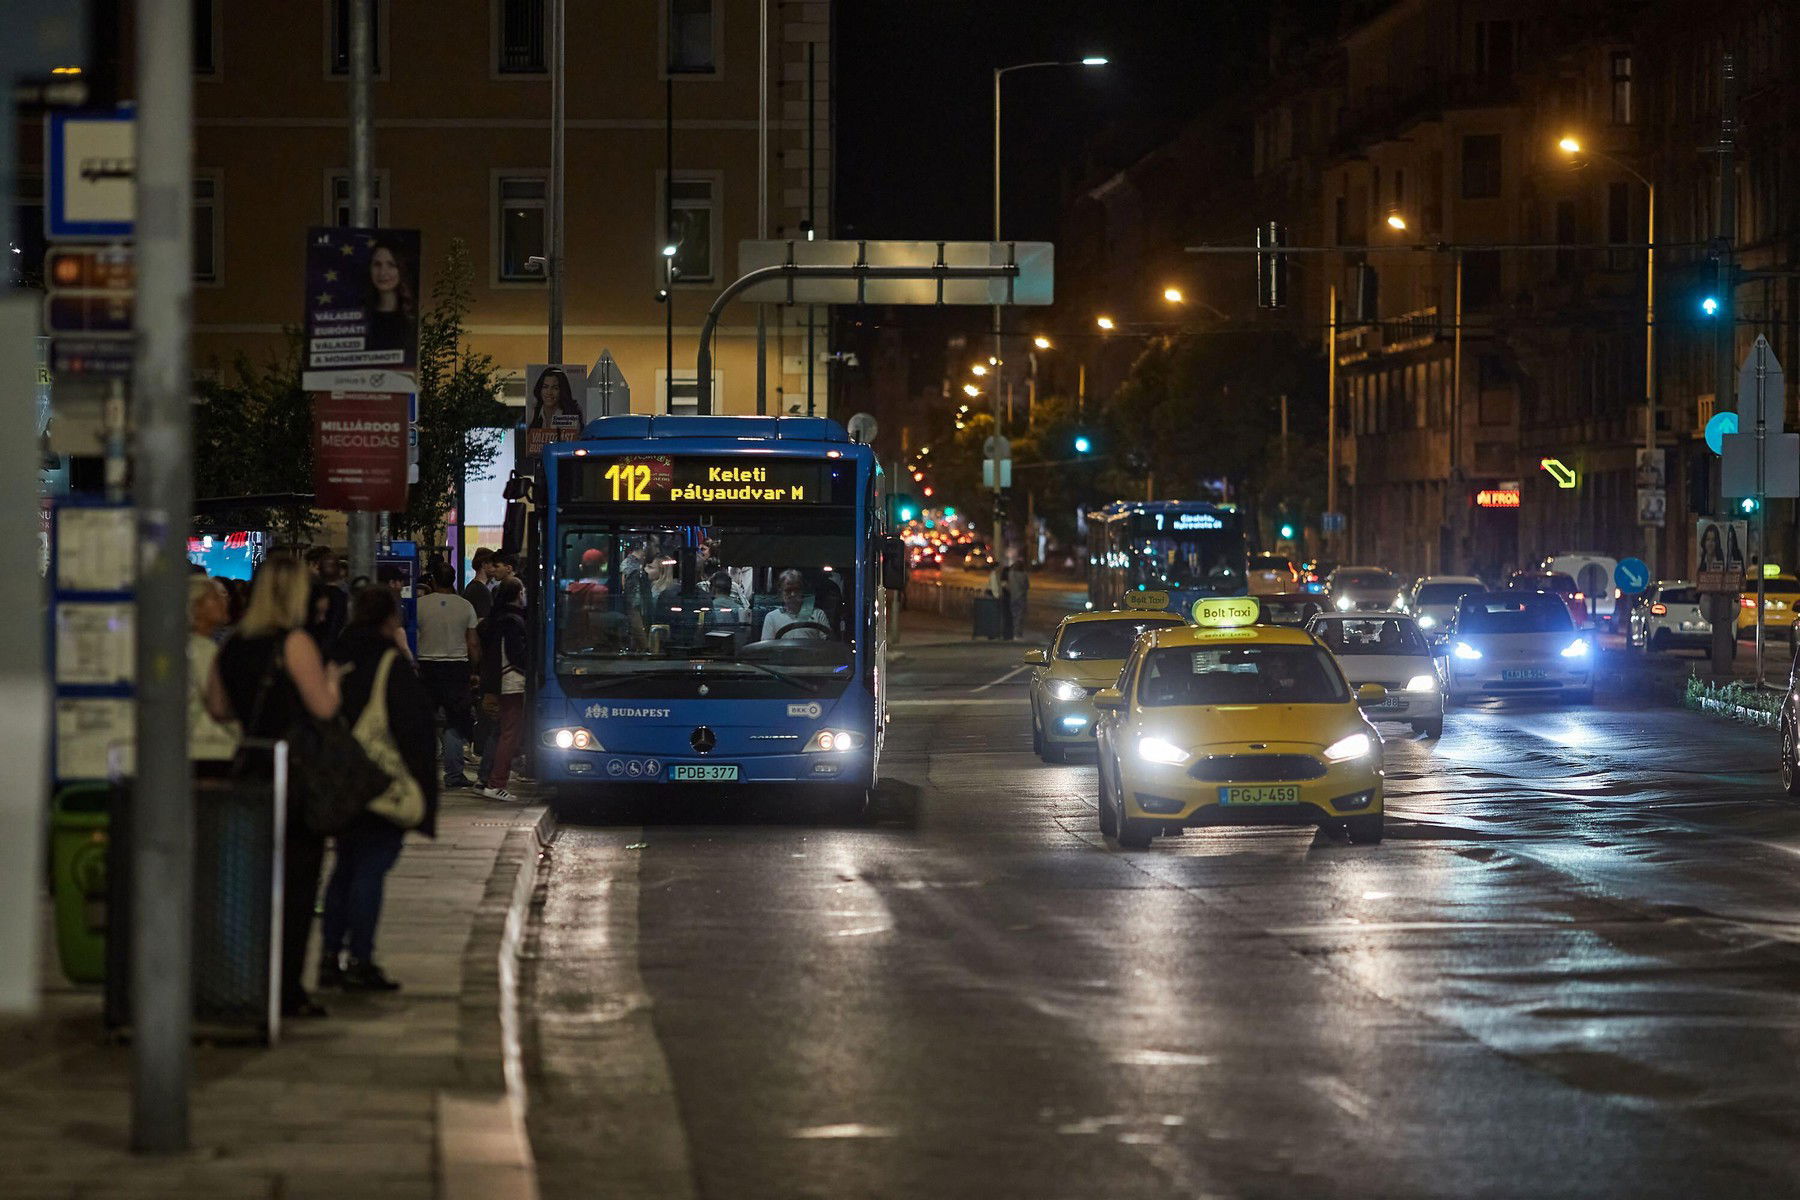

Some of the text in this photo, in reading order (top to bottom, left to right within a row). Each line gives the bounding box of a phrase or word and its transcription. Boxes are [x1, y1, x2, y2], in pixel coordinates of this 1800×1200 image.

[321, 420, 400, 432] MILLIÁRDOS
[321, 433, 400, 448] MEGOLDÁS
[708, 467, 766, 482] Keleti
[605, 465, 650, 500] 112
[671, 484, 803, 501] pályaudvar M
[1155, 514, 1164, 530] 7
[1131, 596, 1165, 605] Bolt Taxi
[1204, 607, 1251, 618] Bolt Taxi
[611, 708, 670, 717] BUDAPEST
[677, 767, 735, 779] PDB-377
[1231, 788, 1294, 801] PGJ-459
